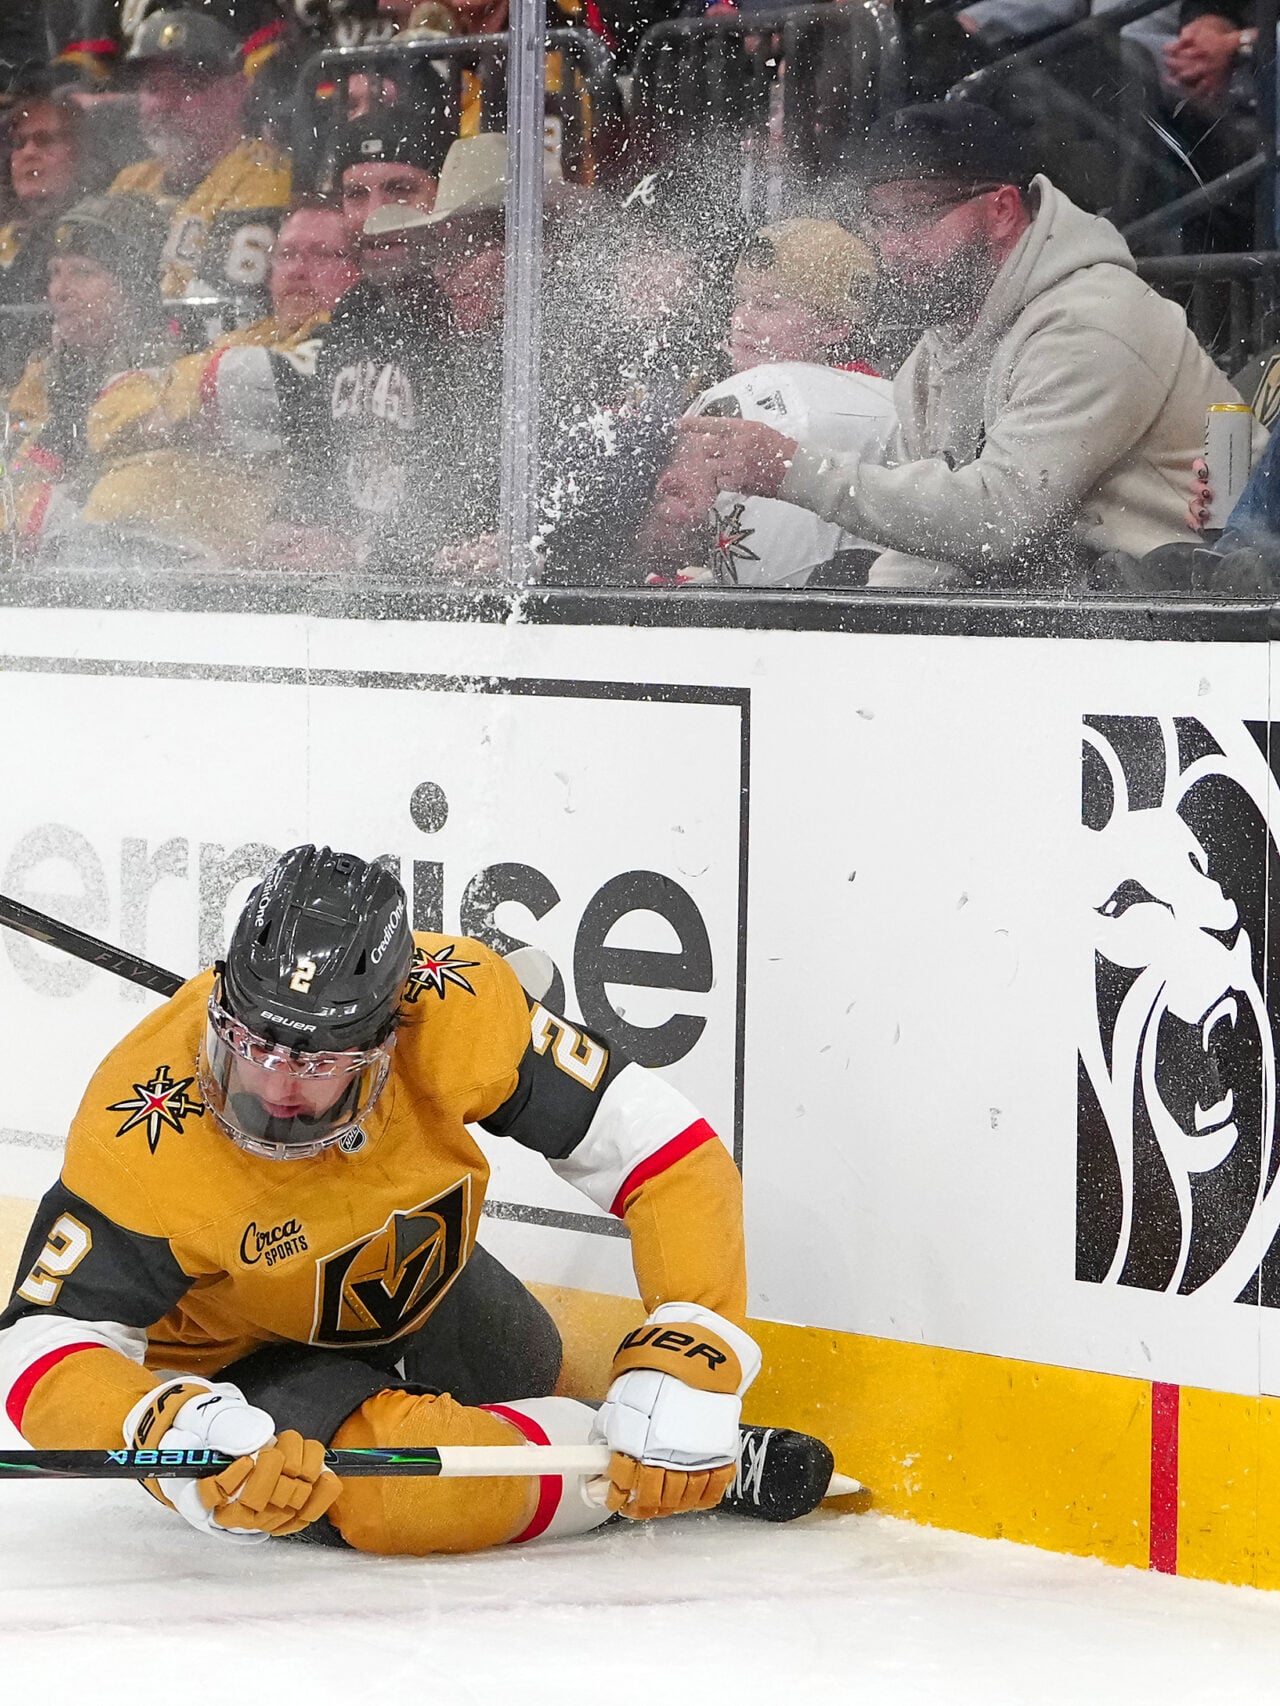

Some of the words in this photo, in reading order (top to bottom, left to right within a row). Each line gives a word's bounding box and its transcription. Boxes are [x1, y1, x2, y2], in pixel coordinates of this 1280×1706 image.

[94, 952, 175, 991] FLYLI
[289, 957, 318, 994] 2
[530, 1001, 609, 1092] 2
[16, 1211, 93, 1307] 2
[240, 1218, 302, 1265] Circa
[264, 1235, 308, 1267] SPORTS
[613, 1327, 727, 1372] UER
[134, 1450, 233, 1465] BAU
